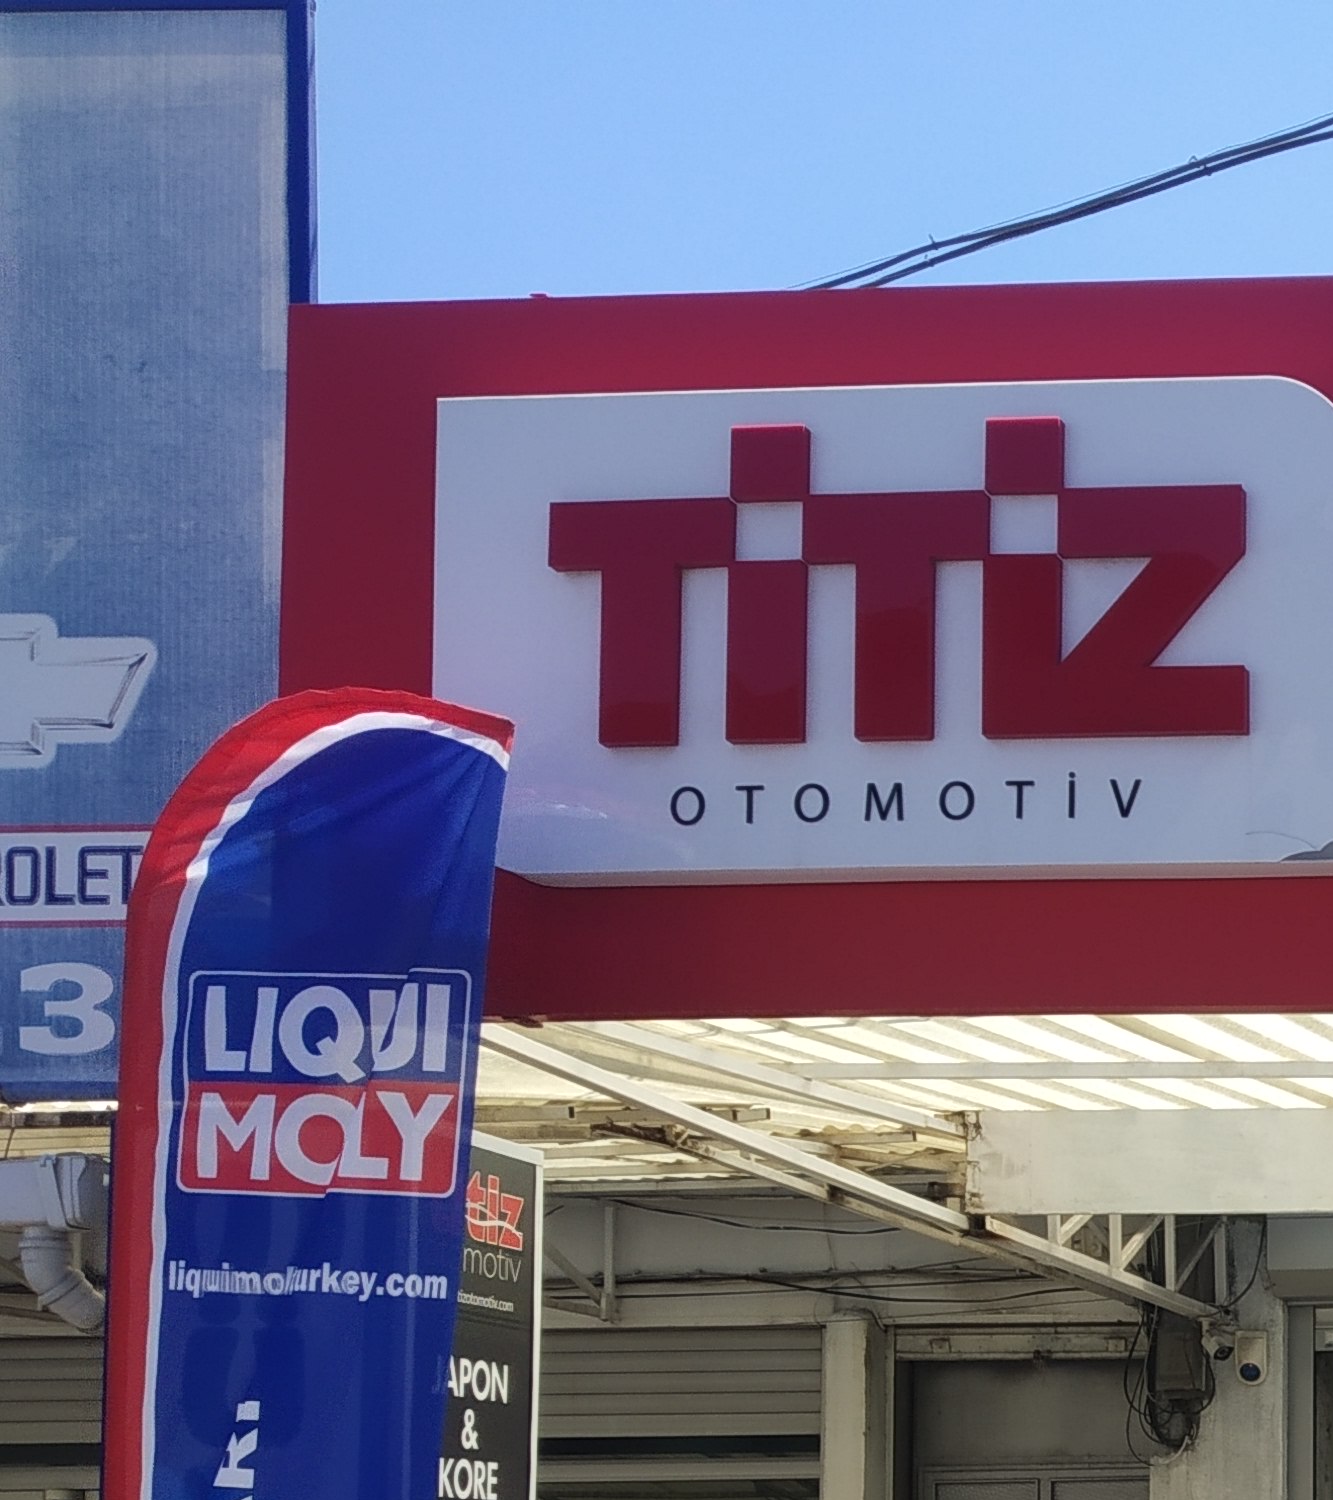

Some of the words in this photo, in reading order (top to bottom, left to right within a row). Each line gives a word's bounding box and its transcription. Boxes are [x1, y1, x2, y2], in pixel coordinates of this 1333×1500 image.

[670, 771, 1142, 826] OTOMOTİV
[0, 846, 144, 906] OLET
[19, 962, 116, 1056] 3
[204, 982, 448, 1084] LIQUI
[199, 1091, 454, 1187] MOLY
[447, 1355, 508, 1404] APON
[461, 1408, 479, 1450] &
[438, 1457, 498, 1500] KORE
